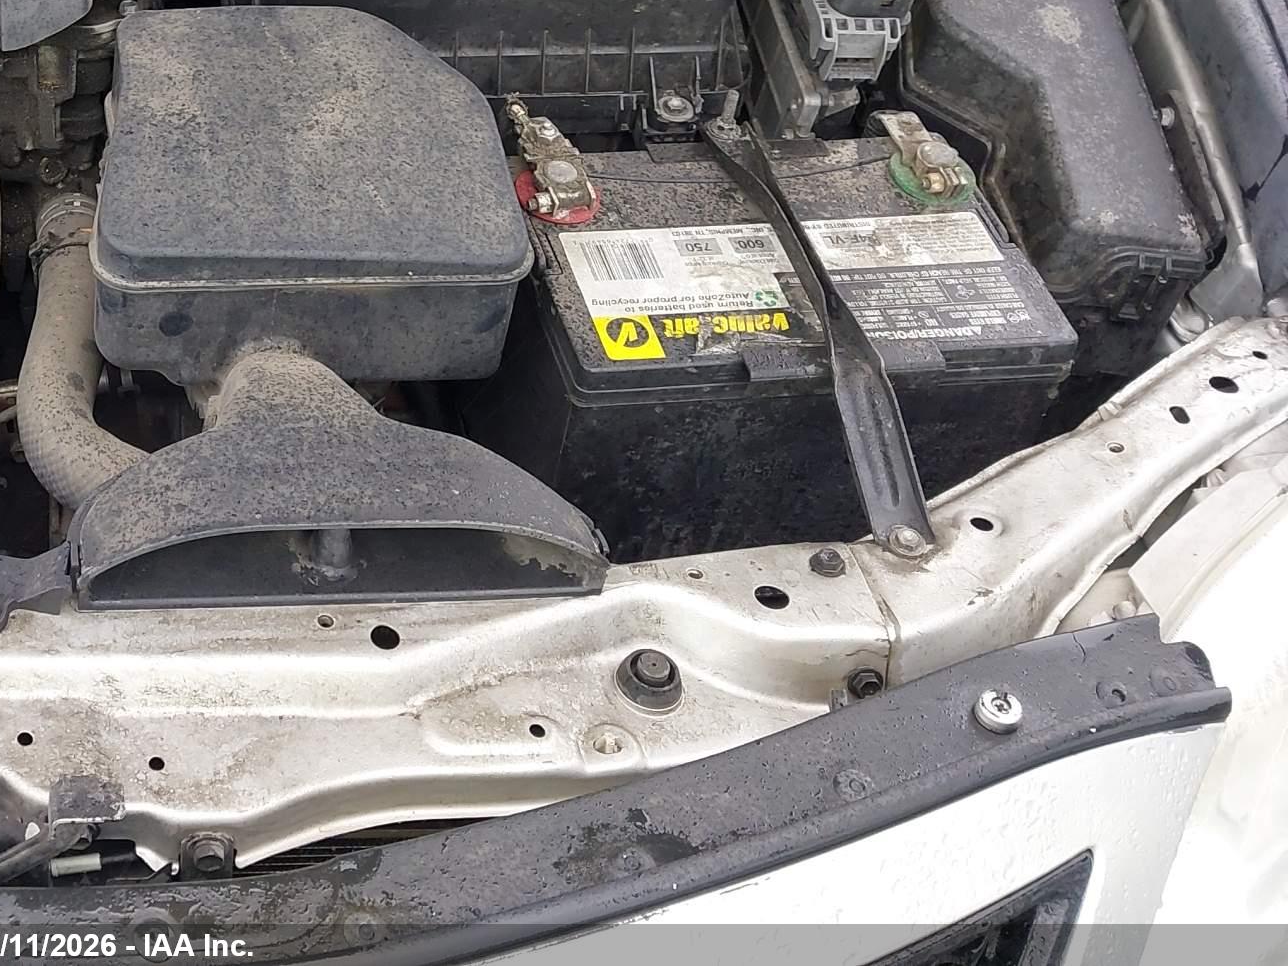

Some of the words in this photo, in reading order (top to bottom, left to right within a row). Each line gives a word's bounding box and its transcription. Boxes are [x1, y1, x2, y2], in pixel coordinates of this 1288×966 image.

[705, 228, 743, 236] MEMPHIS,
[685, 242, 712, 252] 750
[737, 239, 765, 250] 600
[642, 295, 678, 305] proper
[680, 296, 695, 304] for
[698, 292, 750, 302] AutoZone
[591, 298, 640, 308] recycling
[638, 302, 686, 313] batteries
[688, 301, 714, 310] used
[717, 299, 754, 309] Return
